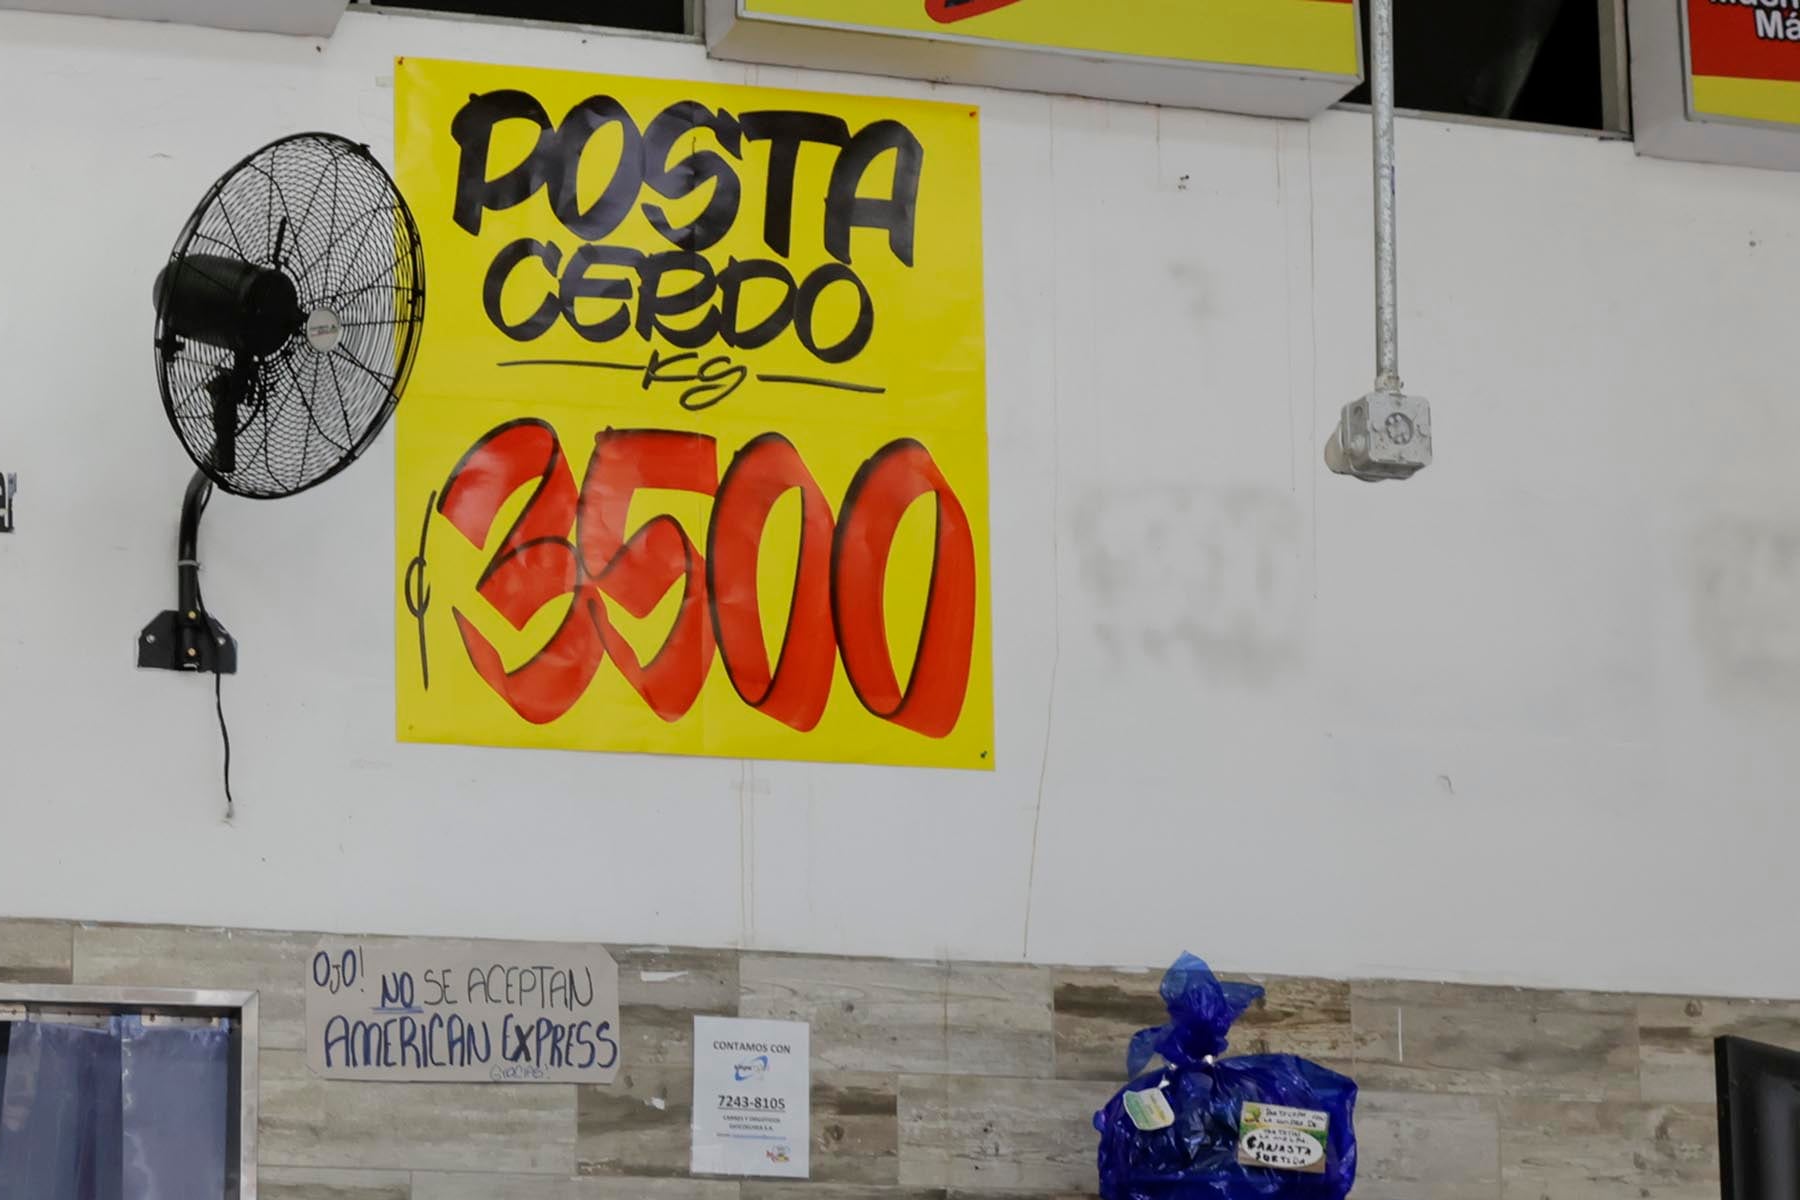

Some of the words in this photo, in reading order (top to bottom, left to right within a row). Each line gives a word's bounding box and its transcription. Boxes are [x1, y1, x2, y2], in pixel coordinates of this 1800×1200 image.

[451, 88, 924, 268] POSTA
[482, 237, 874, 363] CERDO
[381, 972, 414, 1008] NO
[424, 969, 458, 1005] SE
[468, 964, 593, 1011] ACEPTAN
[325, 1013, 491, 1068] AMERICAN
[502, 1013, 617, 1068] EXPRESS
[713, 1040, 768, 1053] CONTAMOS
[770, 1044, 791, 1054] CON
[718, 1095, 786, 1110] 7243-8105
